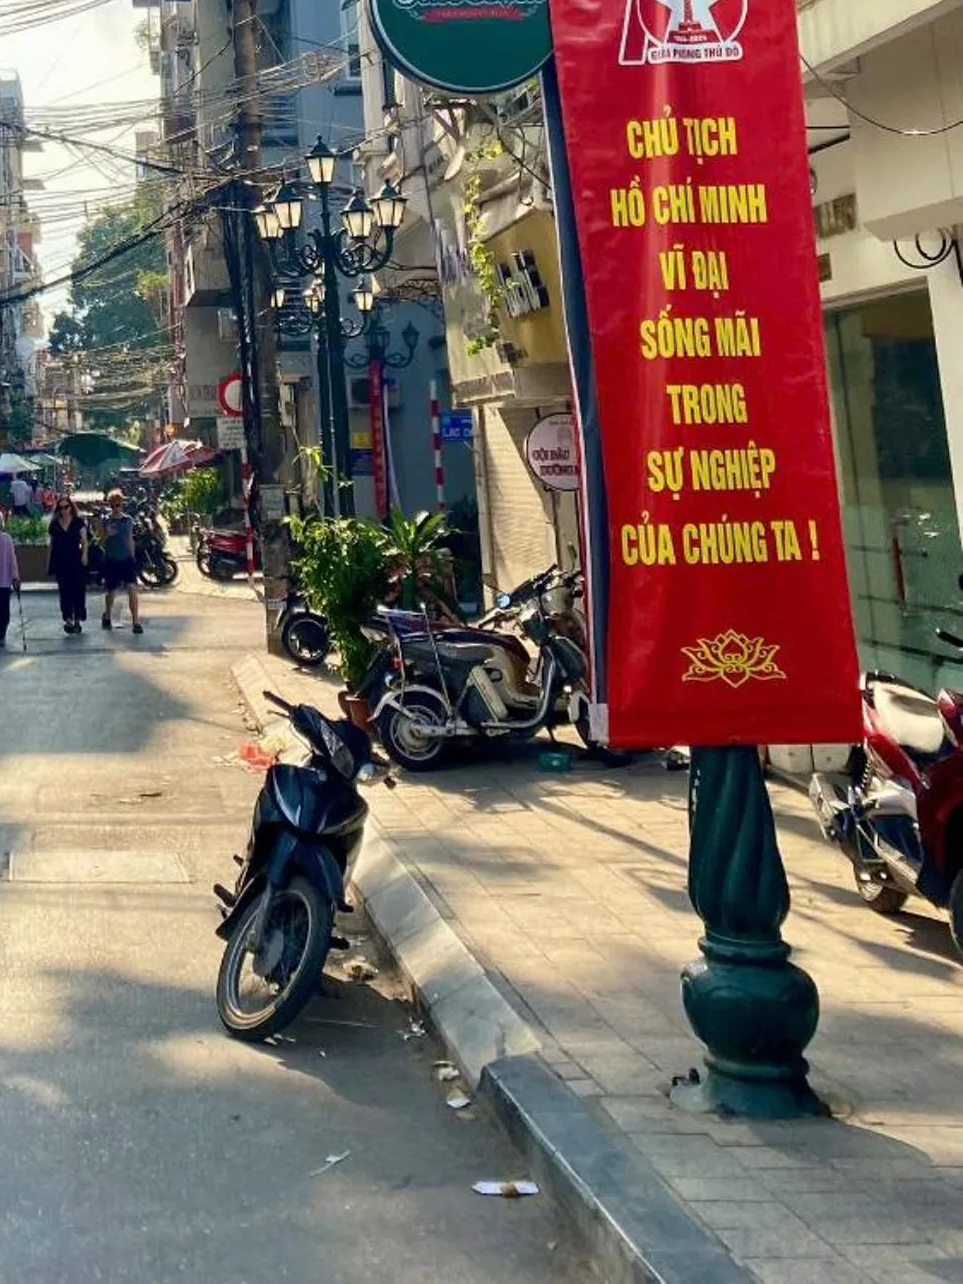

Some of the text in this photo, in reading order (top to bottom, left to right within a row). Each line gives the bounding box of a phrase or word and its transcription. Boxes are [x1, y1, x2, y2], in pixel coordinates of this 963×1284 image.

[627, 105, 737, 165] CHỦ TỊCH
[610, 175, 645, 227] HỒ
[653, 176, 696, 225] CHÍ
[698, 184, 768, 224] MINH
[659, 243, 729, 299] VĨ ĐẠI
[640, 303, 761, 360] SỐNG MÃI
[666, 383, 748, 425] TRONG
[647, 440, 776, 501] SỰ NGHIỆP
[621, 510, 676, 566] CỦA
[682, 513, 768, 564] CHÚNG
[770, 520, 802, 562] TA
